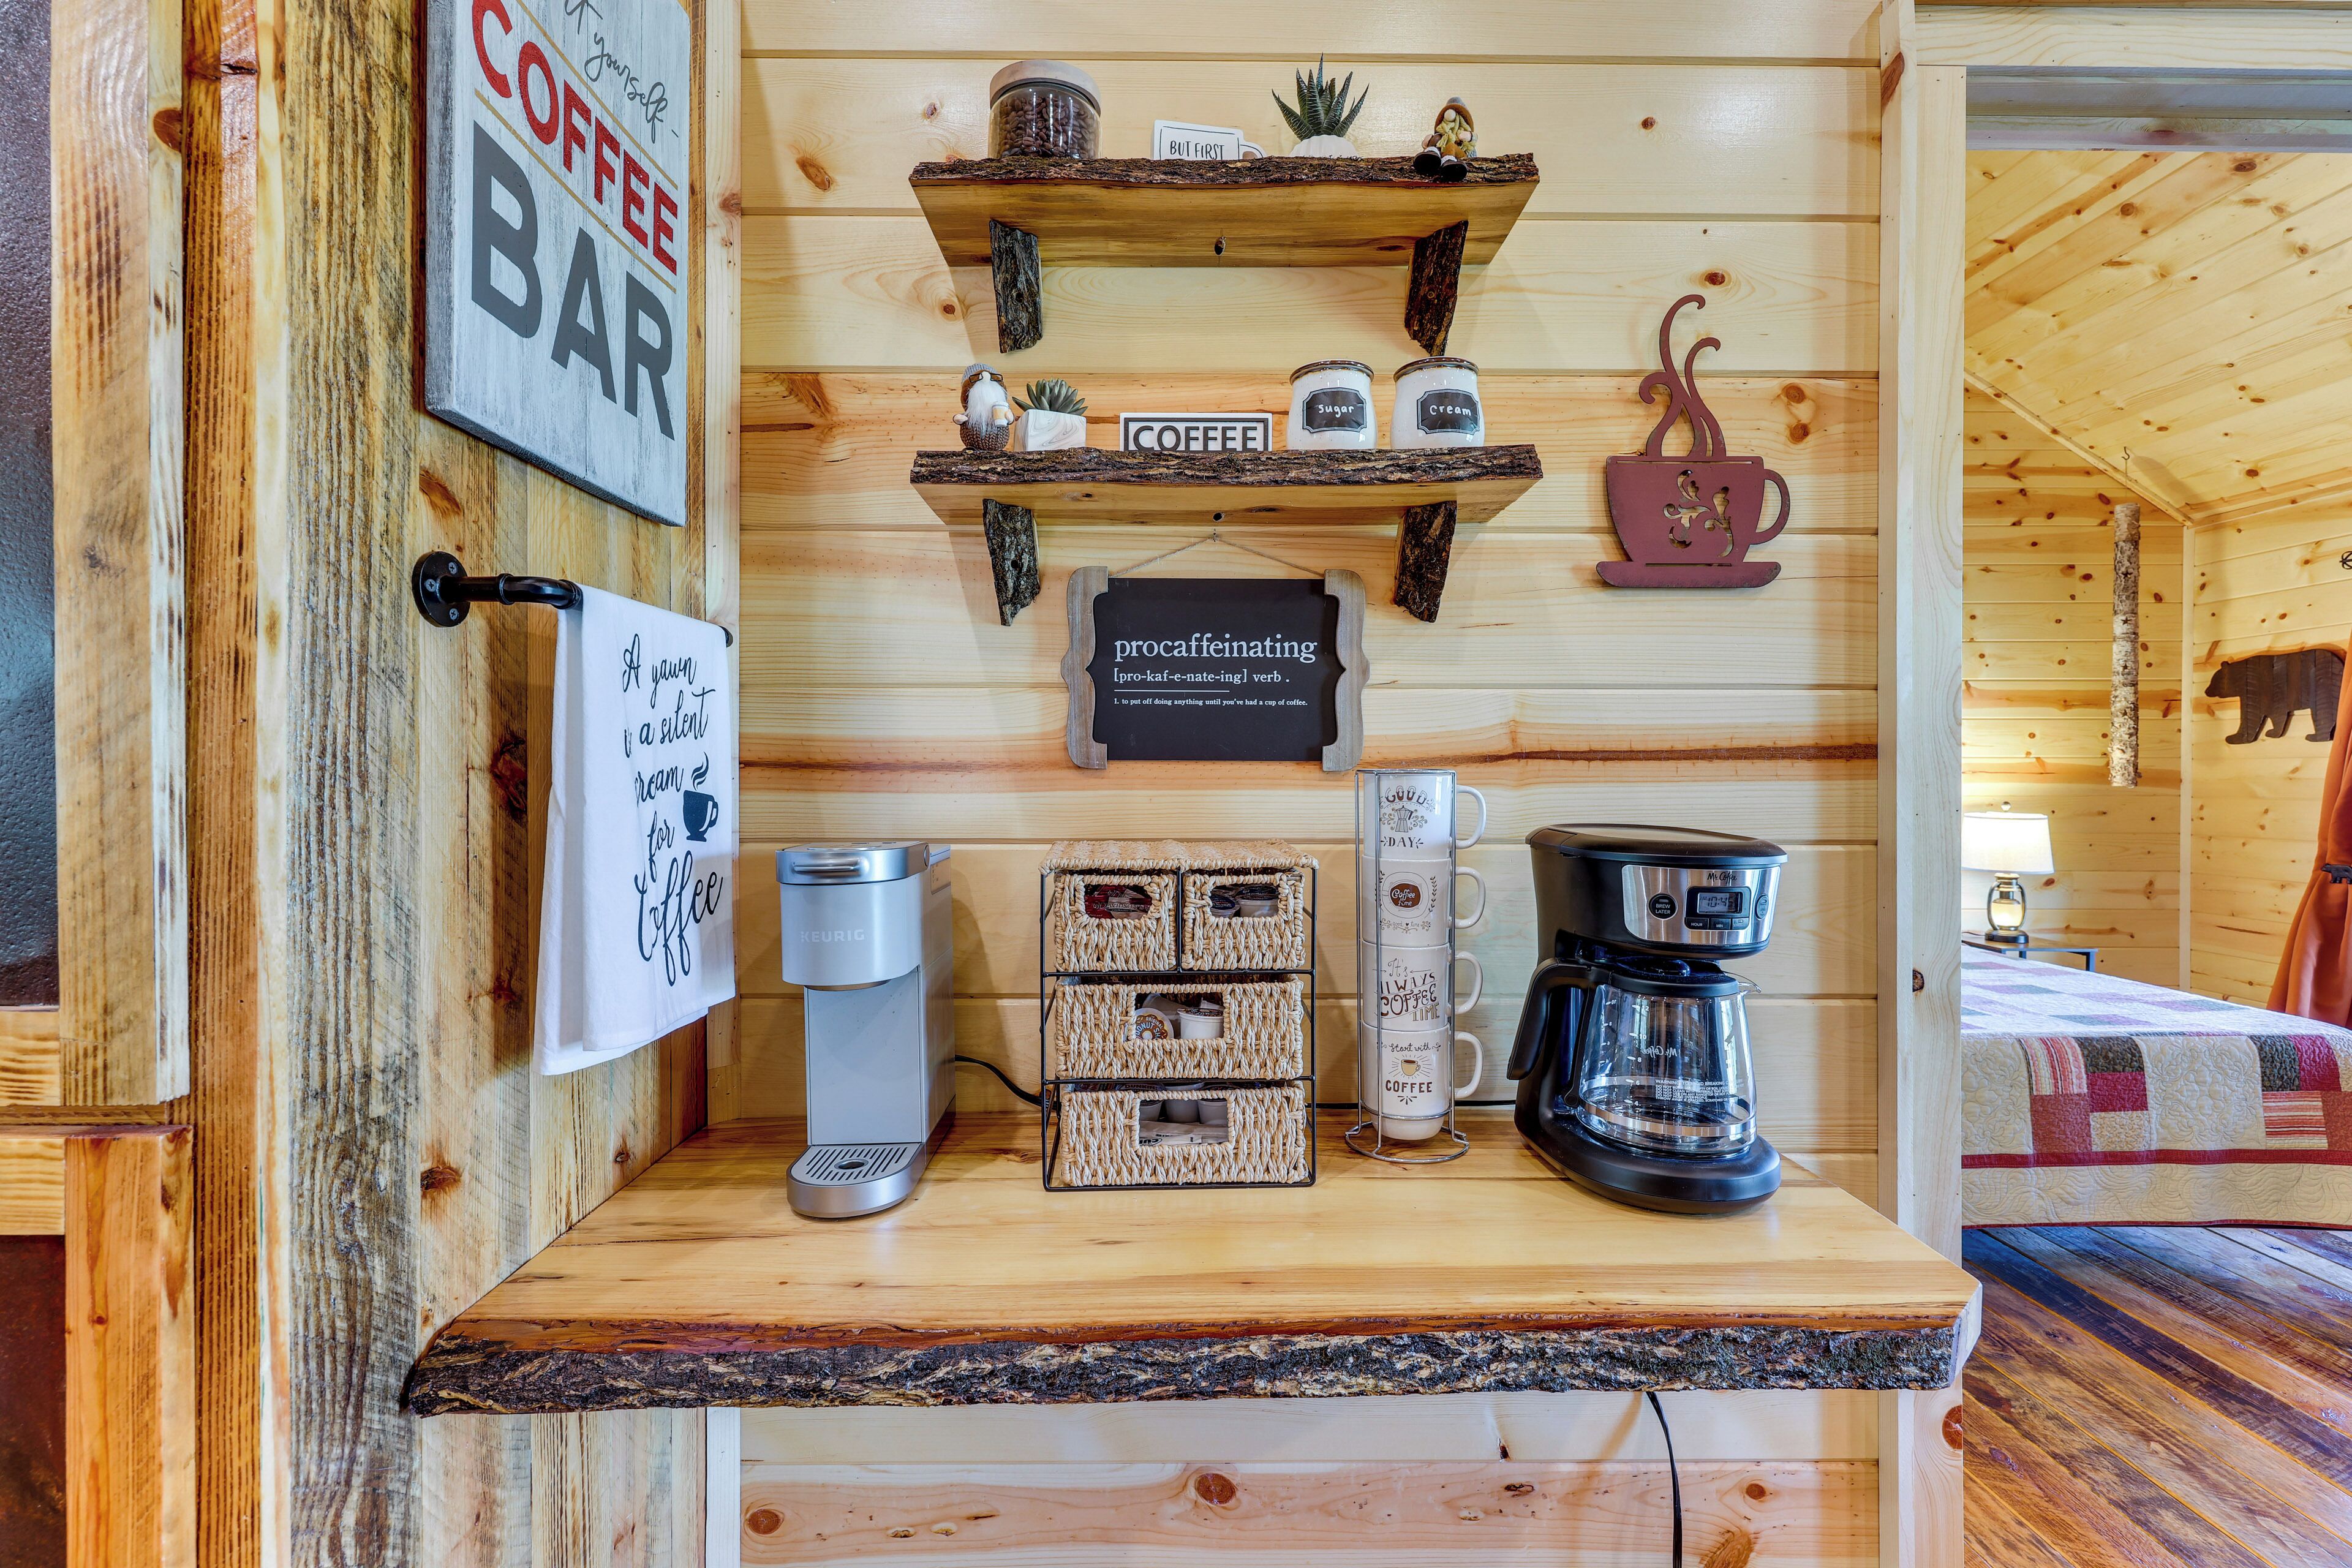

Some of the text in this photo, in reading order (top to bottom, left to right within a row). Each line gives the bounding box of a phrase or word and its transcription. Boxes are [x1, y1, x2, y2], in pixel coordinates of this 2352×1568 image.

[584, 32, 668, 144] yourself
[472, 0, 678, 276] COFFEE
[1169, 140, 1225, 160] BUT FIRST
[471, 120, 676, 441] BAR
[1133, 424, 1258, 451] COFFEE
[1114, 633, 1318, 664] procaffeinating
[622, 633, 697, 709] A yawn
[1114, 668, 1248, 685] [pro-kaf-e-nate-ing]
[1252, 670, 1282, 682] verb
[639, 722, 655, 746] a
[660, 686, 716, 745] silent
[1384, 785, 1428, 805] GOOD
[647, 810, 675, 883] for
[1387, 837, 1417, 848] DAY
[1707, 872, 1738, 884] Mr. Coffee
[1391, 889, 1415, 901] Coffee
[634, 850, 723, 987] Coffee
[1392, 921, 1403, 930] good
[801, 929, 865, 943] KEURIG
[1387, 957, 1408, 978] It's
[1381, 983, 1438, 1017] COFFEE
[1409, 1001, 1440, 1022] TIME
[1135, 1022, 1155, 1036] DONUT
[1145, 1016, 1164, 1030] ORIGINAL
[1414, 1042, 1431, 1052] with
[1385, 1079, 1433, 1093] COFFEE
